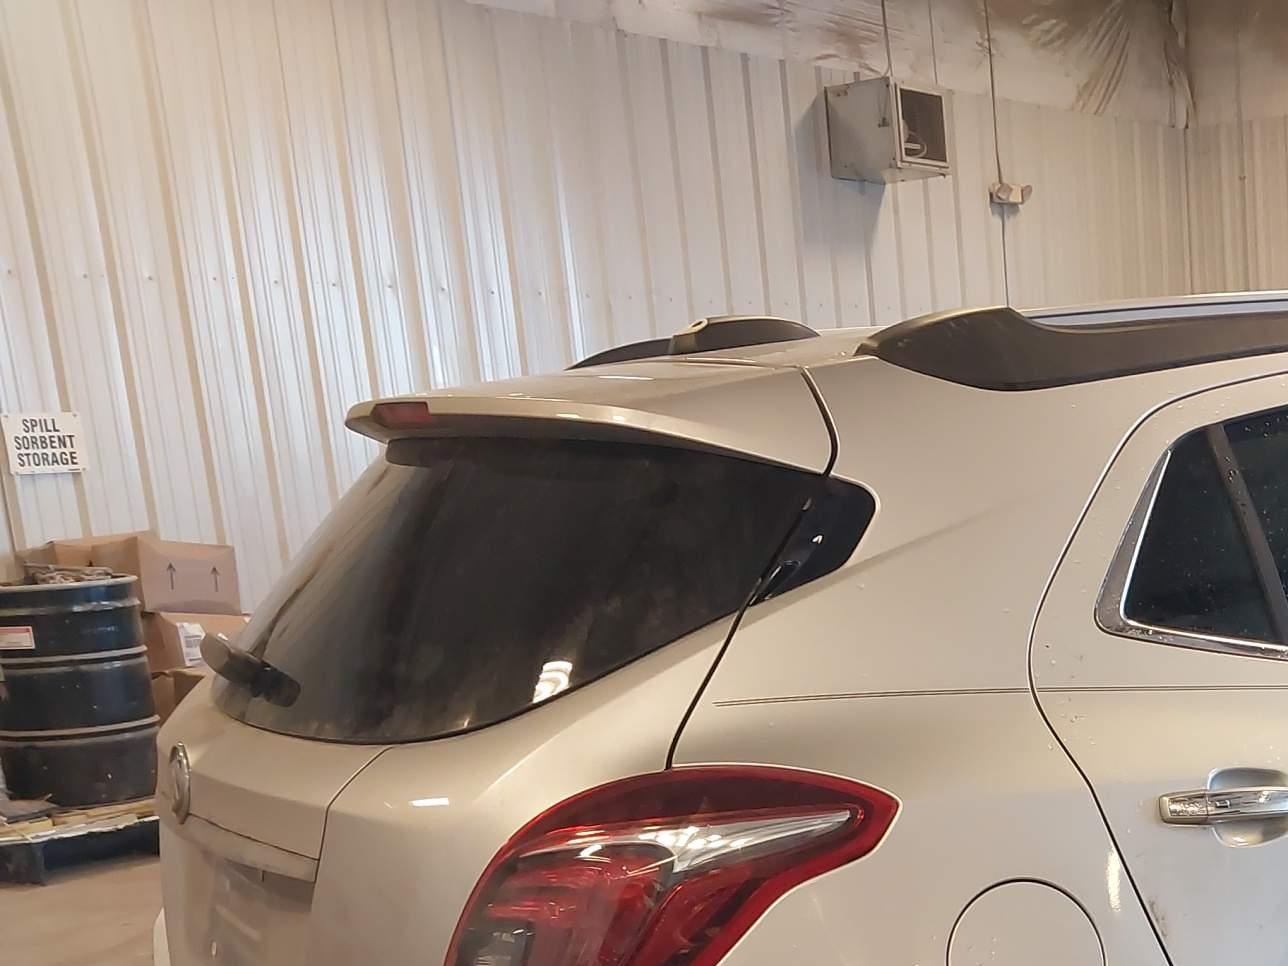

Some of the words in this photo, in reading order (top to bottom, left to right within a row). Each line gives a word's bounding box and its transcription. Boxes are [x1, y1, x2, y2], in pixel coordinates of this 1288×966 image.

[21, 418, 60, 433] SPILL
[14, 435, 75, 450] SORBENT
[17, 451, 79, 467] STORAGE
